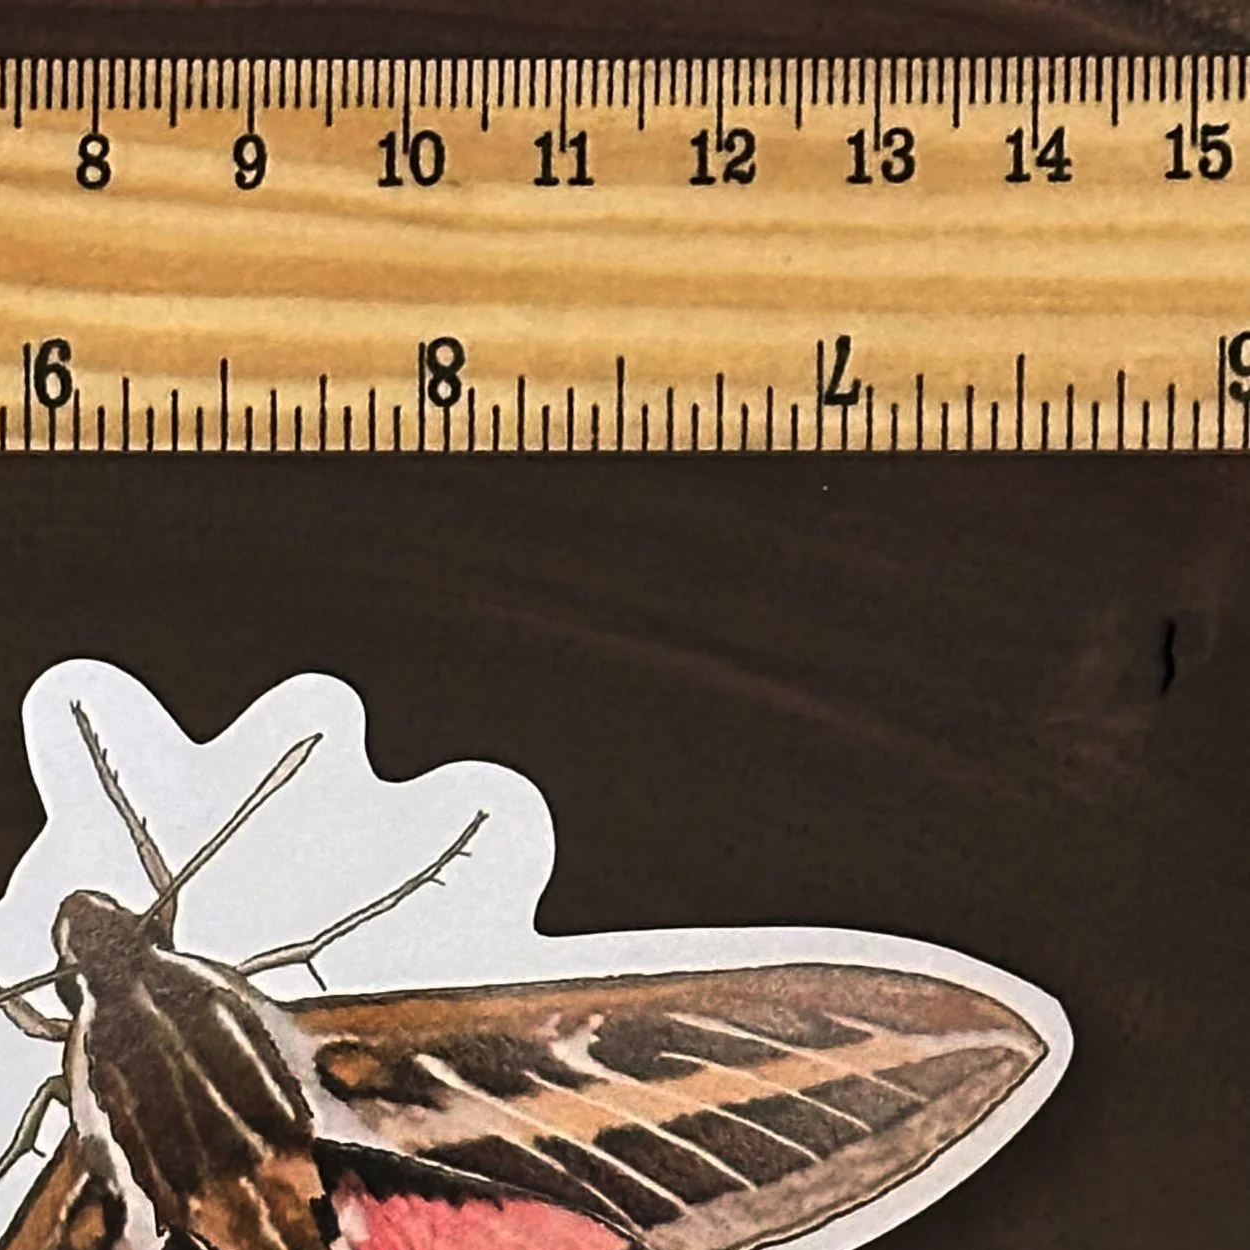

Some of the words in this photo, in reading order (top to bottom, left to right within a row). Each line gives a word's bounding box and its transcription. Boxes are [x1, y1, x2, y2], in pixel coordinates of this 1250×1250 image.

[76, 134, 112, 190] 8
[232, 132, 267, 189] 9
[377, 130, 446, 187] 10
[532, 130, 595, 187] 11
[689, 128, 757, 187] 12
[846, 126, 917, 185] 13
[1004, 126, 1073, 184] 14
[1164, 123, 1233, 181] 15
[34, 338, 72, 408] 9
[425, 336, 466, 408] 8
[822, 335, 861, 406] 7
